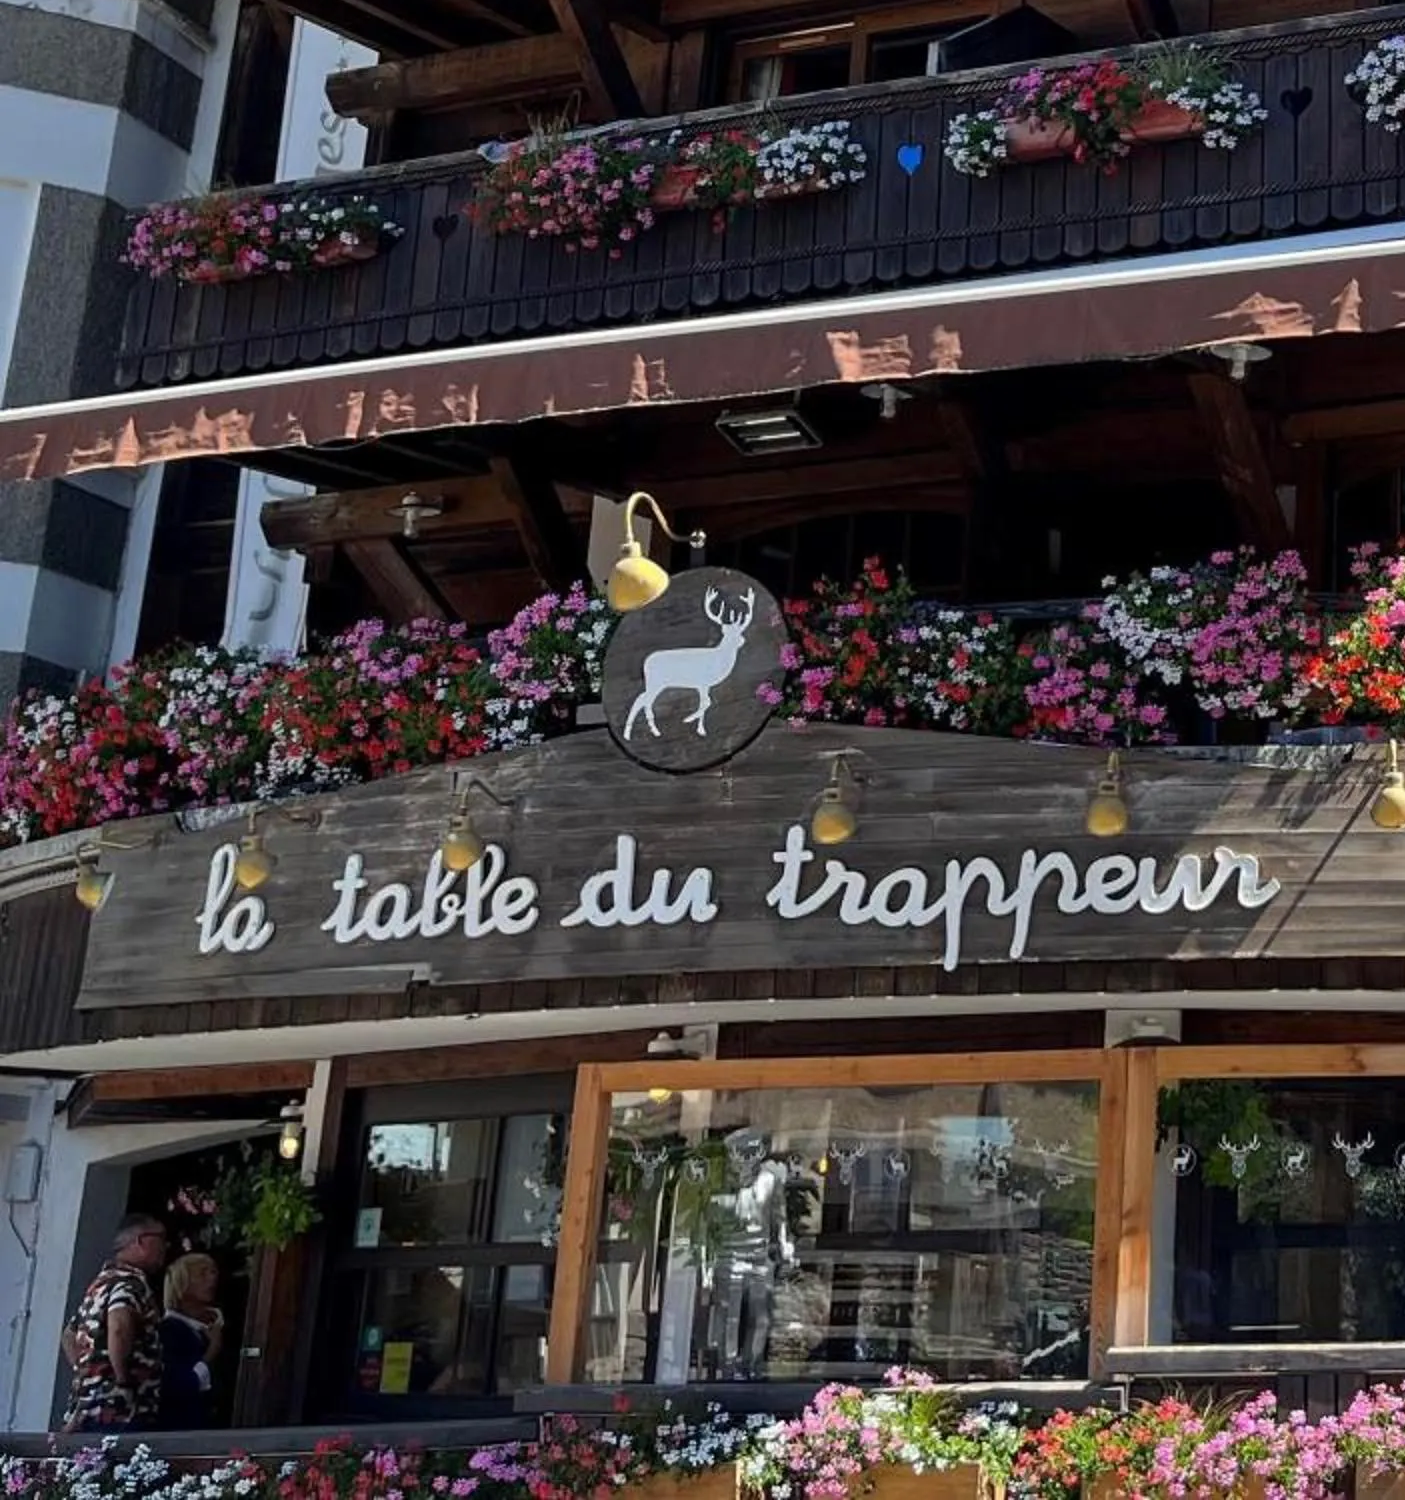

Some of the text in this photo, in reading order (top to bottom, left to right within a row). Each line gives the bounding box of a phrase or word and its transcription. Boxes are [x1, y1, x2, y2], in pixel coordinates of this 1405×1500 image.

[196, 824, 1281, 972] la table du trappeur
